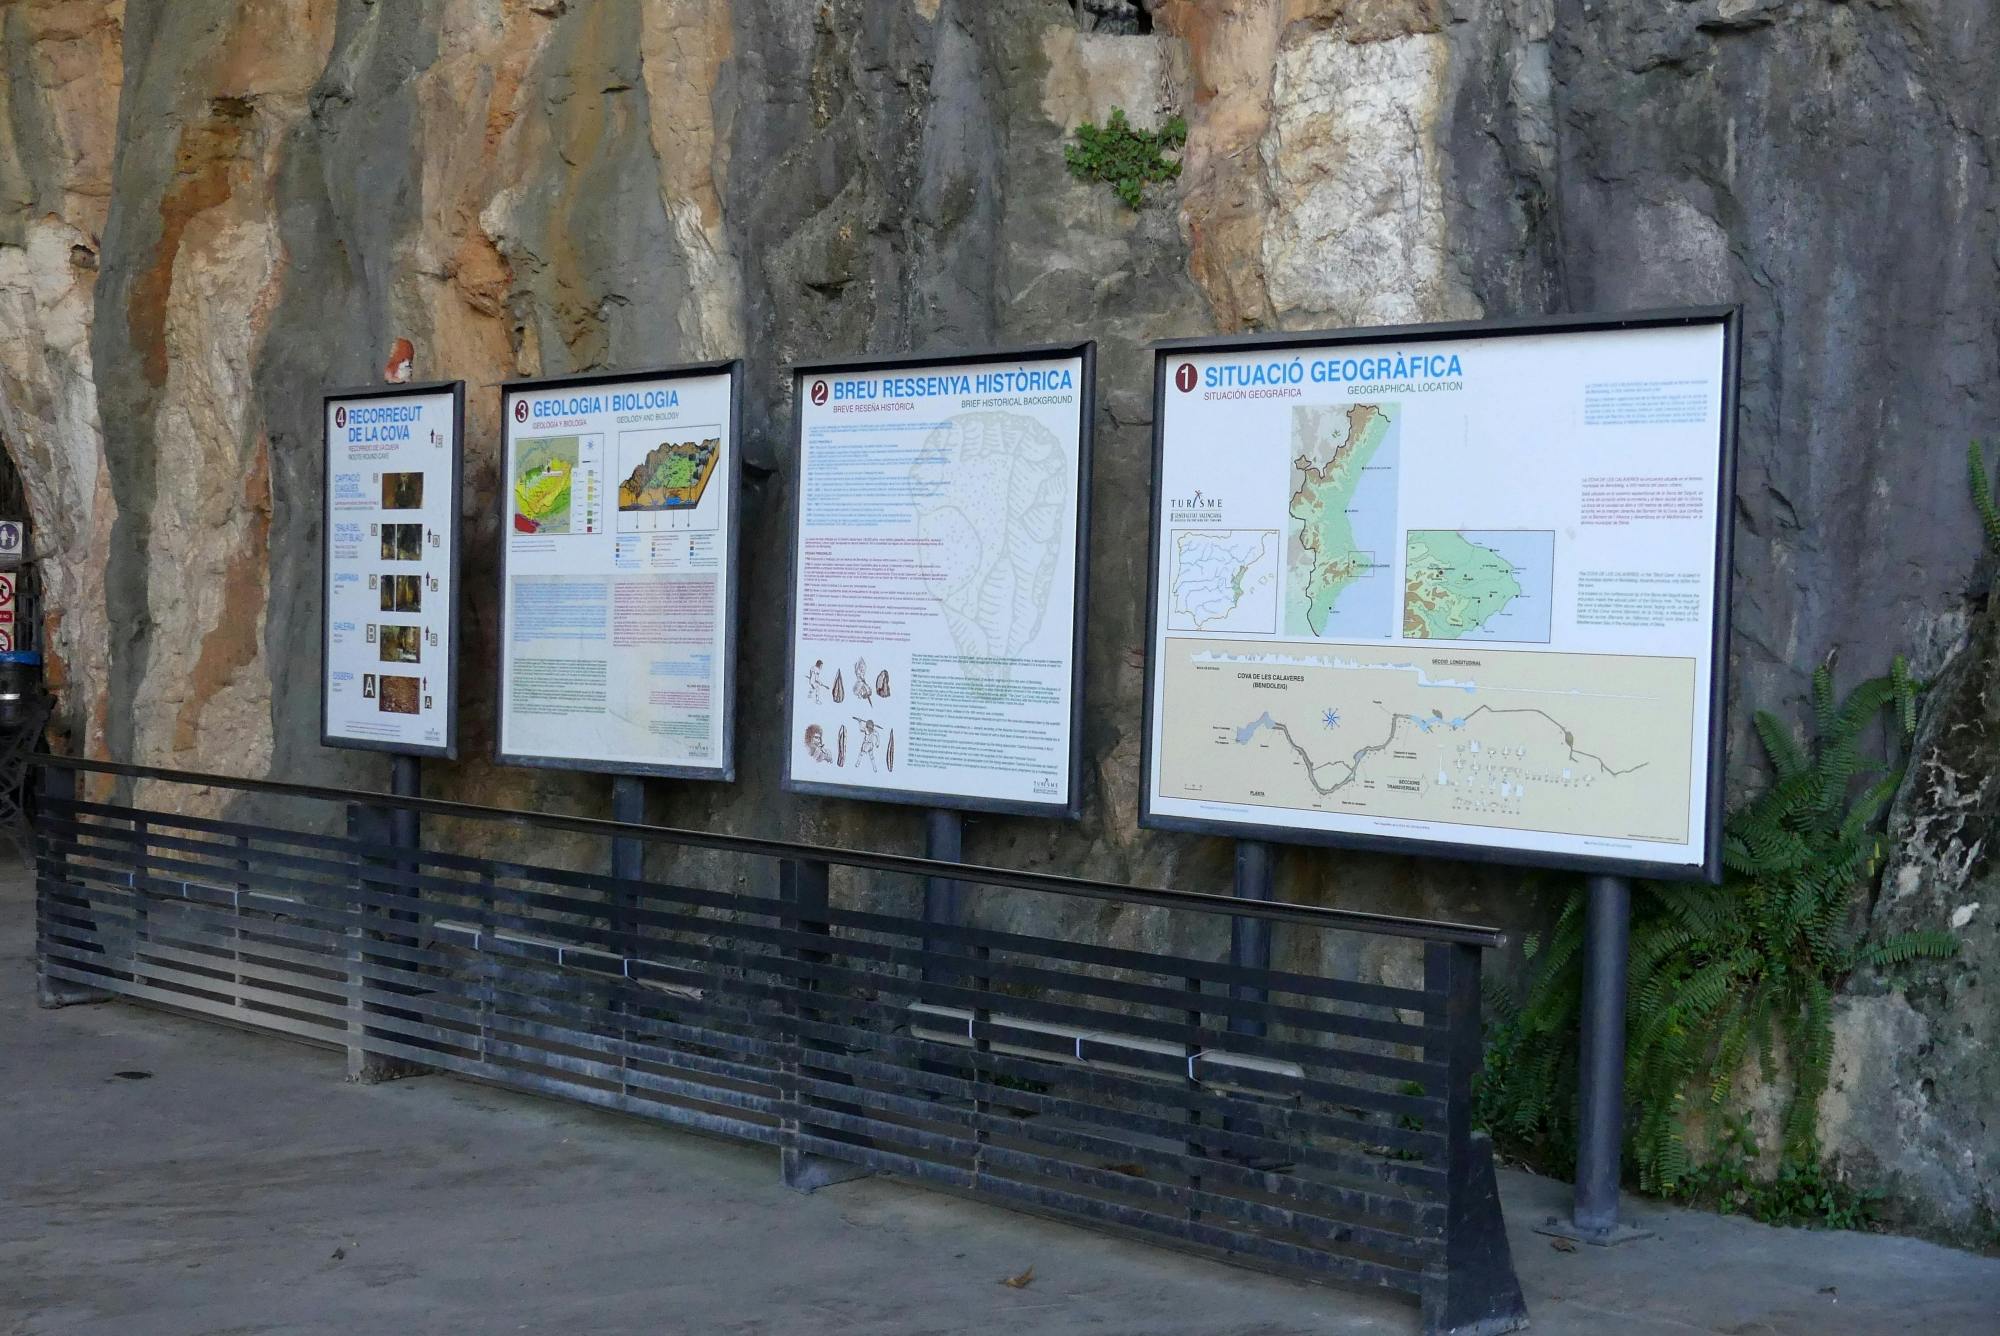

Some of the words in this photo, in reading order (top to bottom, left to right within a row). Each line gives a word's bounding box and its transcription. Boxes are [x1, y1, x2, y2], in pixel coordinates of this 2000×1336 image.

[1181, 365, 1189, 390] 1
[1205, 356, 1304, 388] SITUACIÓ
[1311, 352, 1462, 383] GEOGRÀFICA
[815, 382, 825, 404] 2
[834, 381, 877, 400] BREU
[883, 375, 970, 398] RESSENYA
[976, 366, 1072, 393] HISTÒRICA
[1347, 384, 1416, 395] GEOGRAPHICAL
[1417, 382, 1463, 392] LOCATION
[961, 400, 981, 408] BRIEF
[982, 397, 1022, 407] HISTORICAL
[1023, 395, 1073, 406] BACKGROUND
[1248, 388, 1302, 399] GEOGRÁFICA
[517, 401, 526, 420] 3
[533, 397, 600, 418] GEOLOGIA
[605, 395, 608, 413] I
[613, 390, 679, 411] BIOLOGIA
[833, 404, 854, 413] BREVE
[855, 402, 880, 412] RESEÑA
[880, 401, 915, 411] HISTÓRICA
[337, 409, 344, 427] 4
[349, 406, 422, 424] RECORREGUT
[617, 415, 642, 423] GEOLOGY
[656, 412, 679, 420] BIOLOGY
[349, 427, 362, 442] DE
[365, 426, 378, 441] LA
[381, 425, 409, 441] COVA
[1171, 490, 1222, 508] TURISME
[368, 625, 375, 641] B
[1237, 672, 1252, 680] COVA
[1272, 674, 1305, 682] CALAVERES
[364, 676, 375, 697] A
